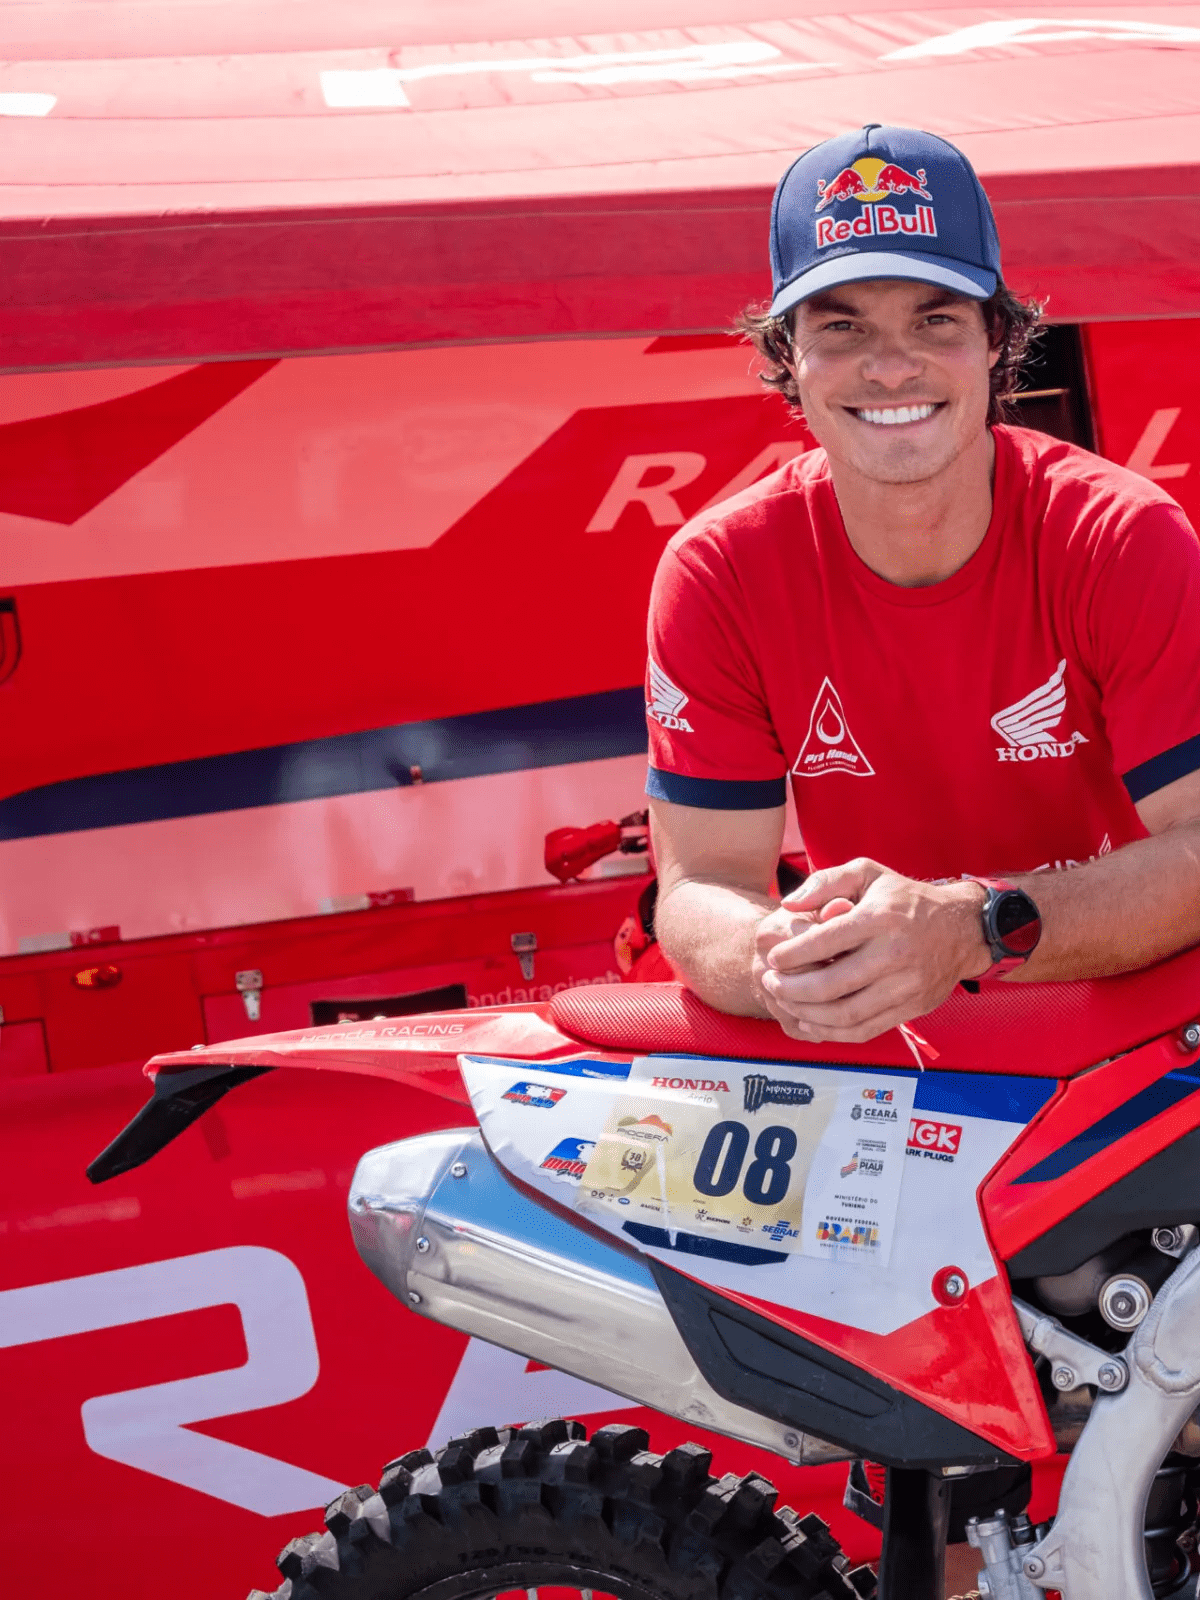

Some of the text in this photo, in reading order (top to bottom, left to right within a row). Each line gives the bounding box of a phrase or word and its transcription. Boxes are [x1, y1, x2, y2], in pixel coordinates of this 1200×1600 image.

[816, 204, 938, 249] Red Bull
[996, 731, 1089, 762] HONDA
[300, 1024, 464, 1043] Honda RACING
[651, 1077, 731, 1093] HONDA
[765, 1083, 811, 1097] MONSTER
[864, 1108, 898, 1120] CEARÁ
[693, 1120, 797, 1206] 08
[923, 1151, 955, 1163] PLUGS
[826, 1215, 879, 1226] GOVERNO FEDERAL
[761, 1225, 800, 1239] SEBRAE
[816, 1221, 881, 1248] BRASIL
